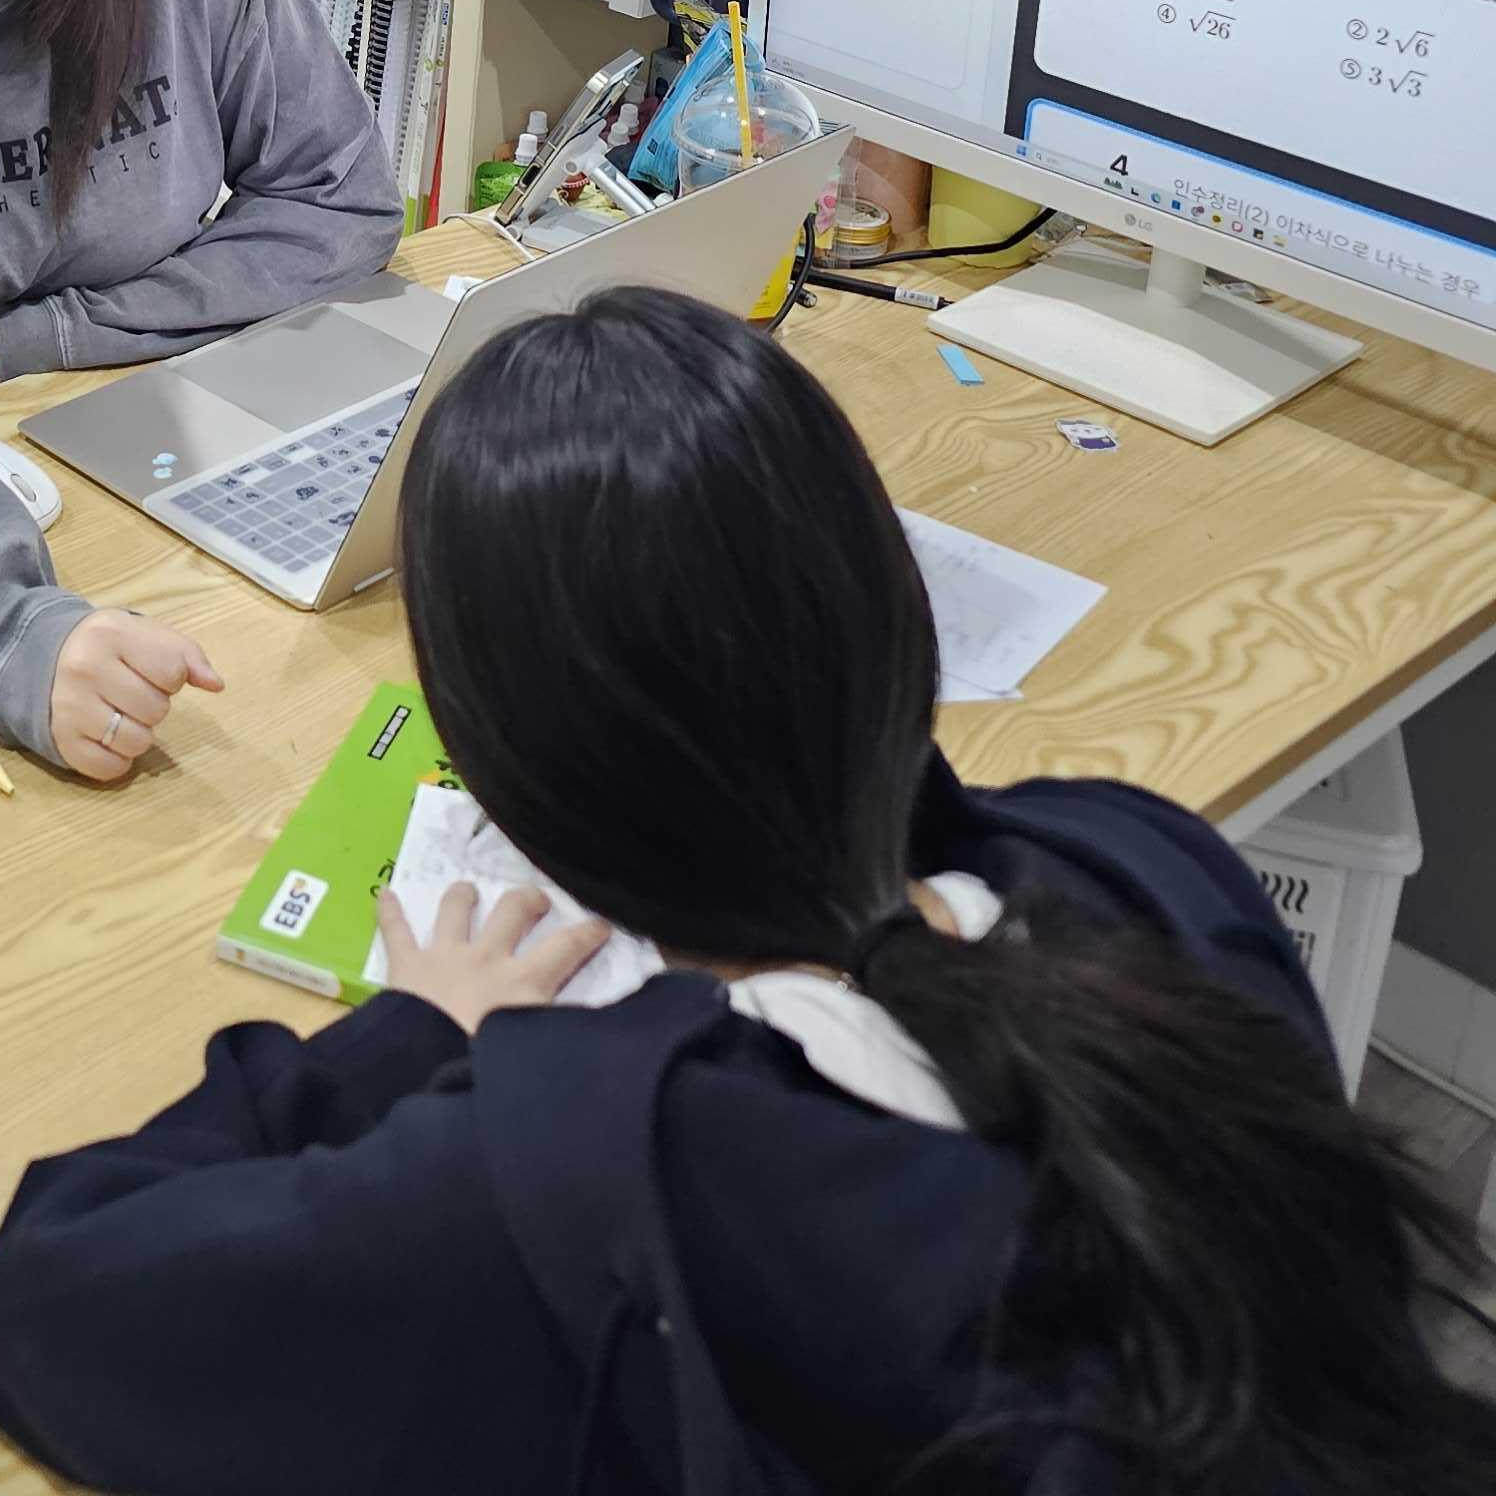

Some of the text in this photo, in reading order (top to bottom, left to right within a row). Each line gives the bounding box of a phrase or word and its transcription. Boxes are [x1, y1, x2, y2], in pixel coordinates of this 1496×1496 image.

[1110, 154, 1128, 176] 4
[1276, 214, 1371, 258] 이차식으로
[1440, 270, 1481, 298] 경우
[273, 887, 312, 929] EBS
